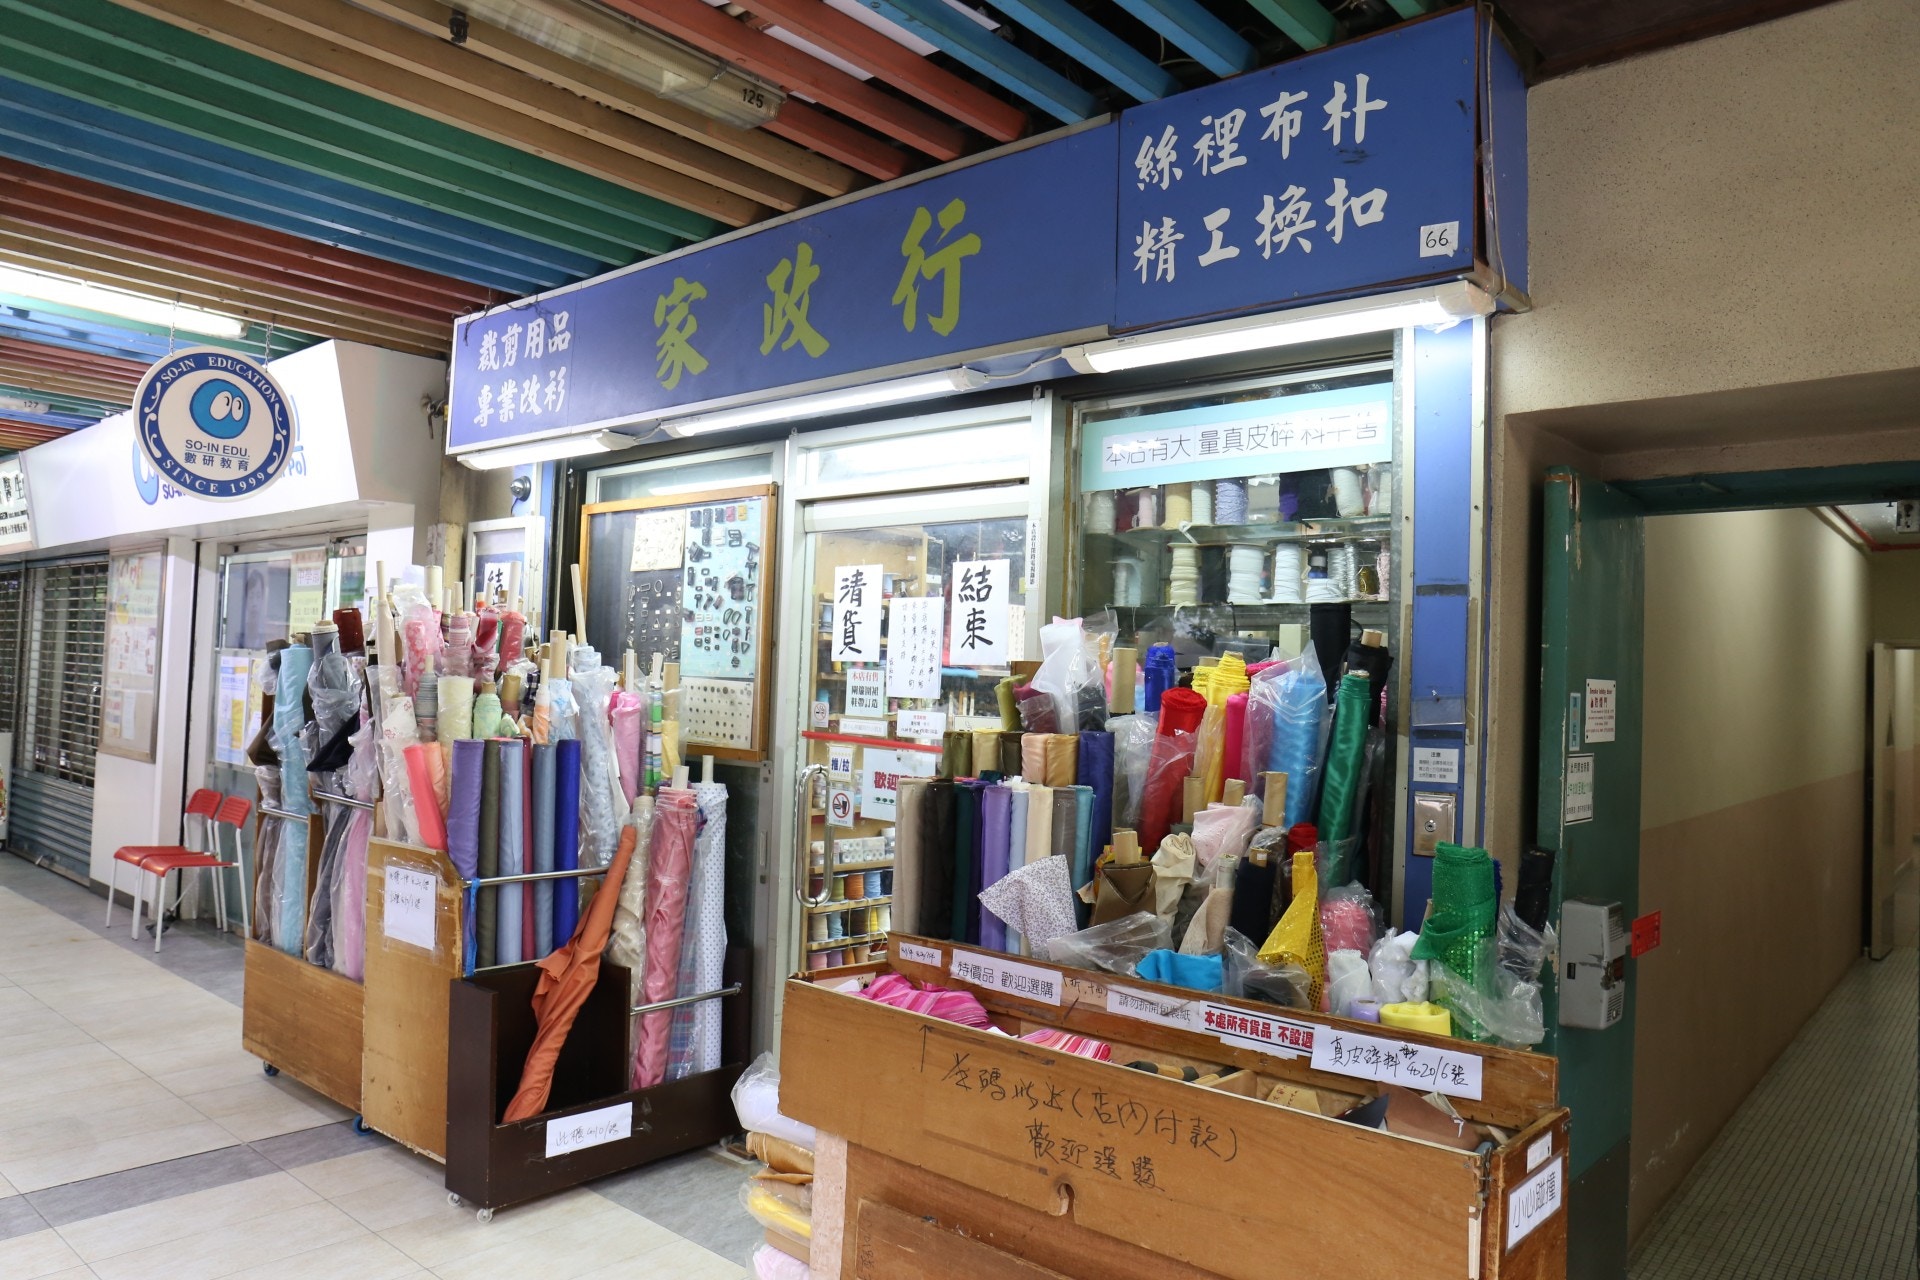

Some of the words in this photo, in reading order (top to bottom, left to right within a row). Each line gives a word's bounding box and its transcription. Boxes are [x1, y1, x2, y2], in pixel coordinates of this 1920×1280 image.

[742, 88, 765, 108] 125
[1133, 178, 1388, 285] 精工換扣
[1425, 228, 1450, 249] 66
[653, 200, 981, 390] 家政行
[477, 310, 570, 372] 裁剪用品
[160, 358, 196, 385] SO-IN
[207, 356, 279, 404] EDUCATION
[184, 452, 249, 472] 數研教育
[185, 439, 219, 452] SO-IN
[222, 445, 251, 458] EDU.
[163, 459, 219, 494] SINCE
[230, 472, 265, 493] 1999
[839, 568, 867, 655] 清貨
[958, 565, 994, 650] 結束
[957, 961, 994, 984] 特價品
[1001, 971, 1054, 999] 歡迎選購
[1204, 1010, 1272, 1040] 本處所有貨品
